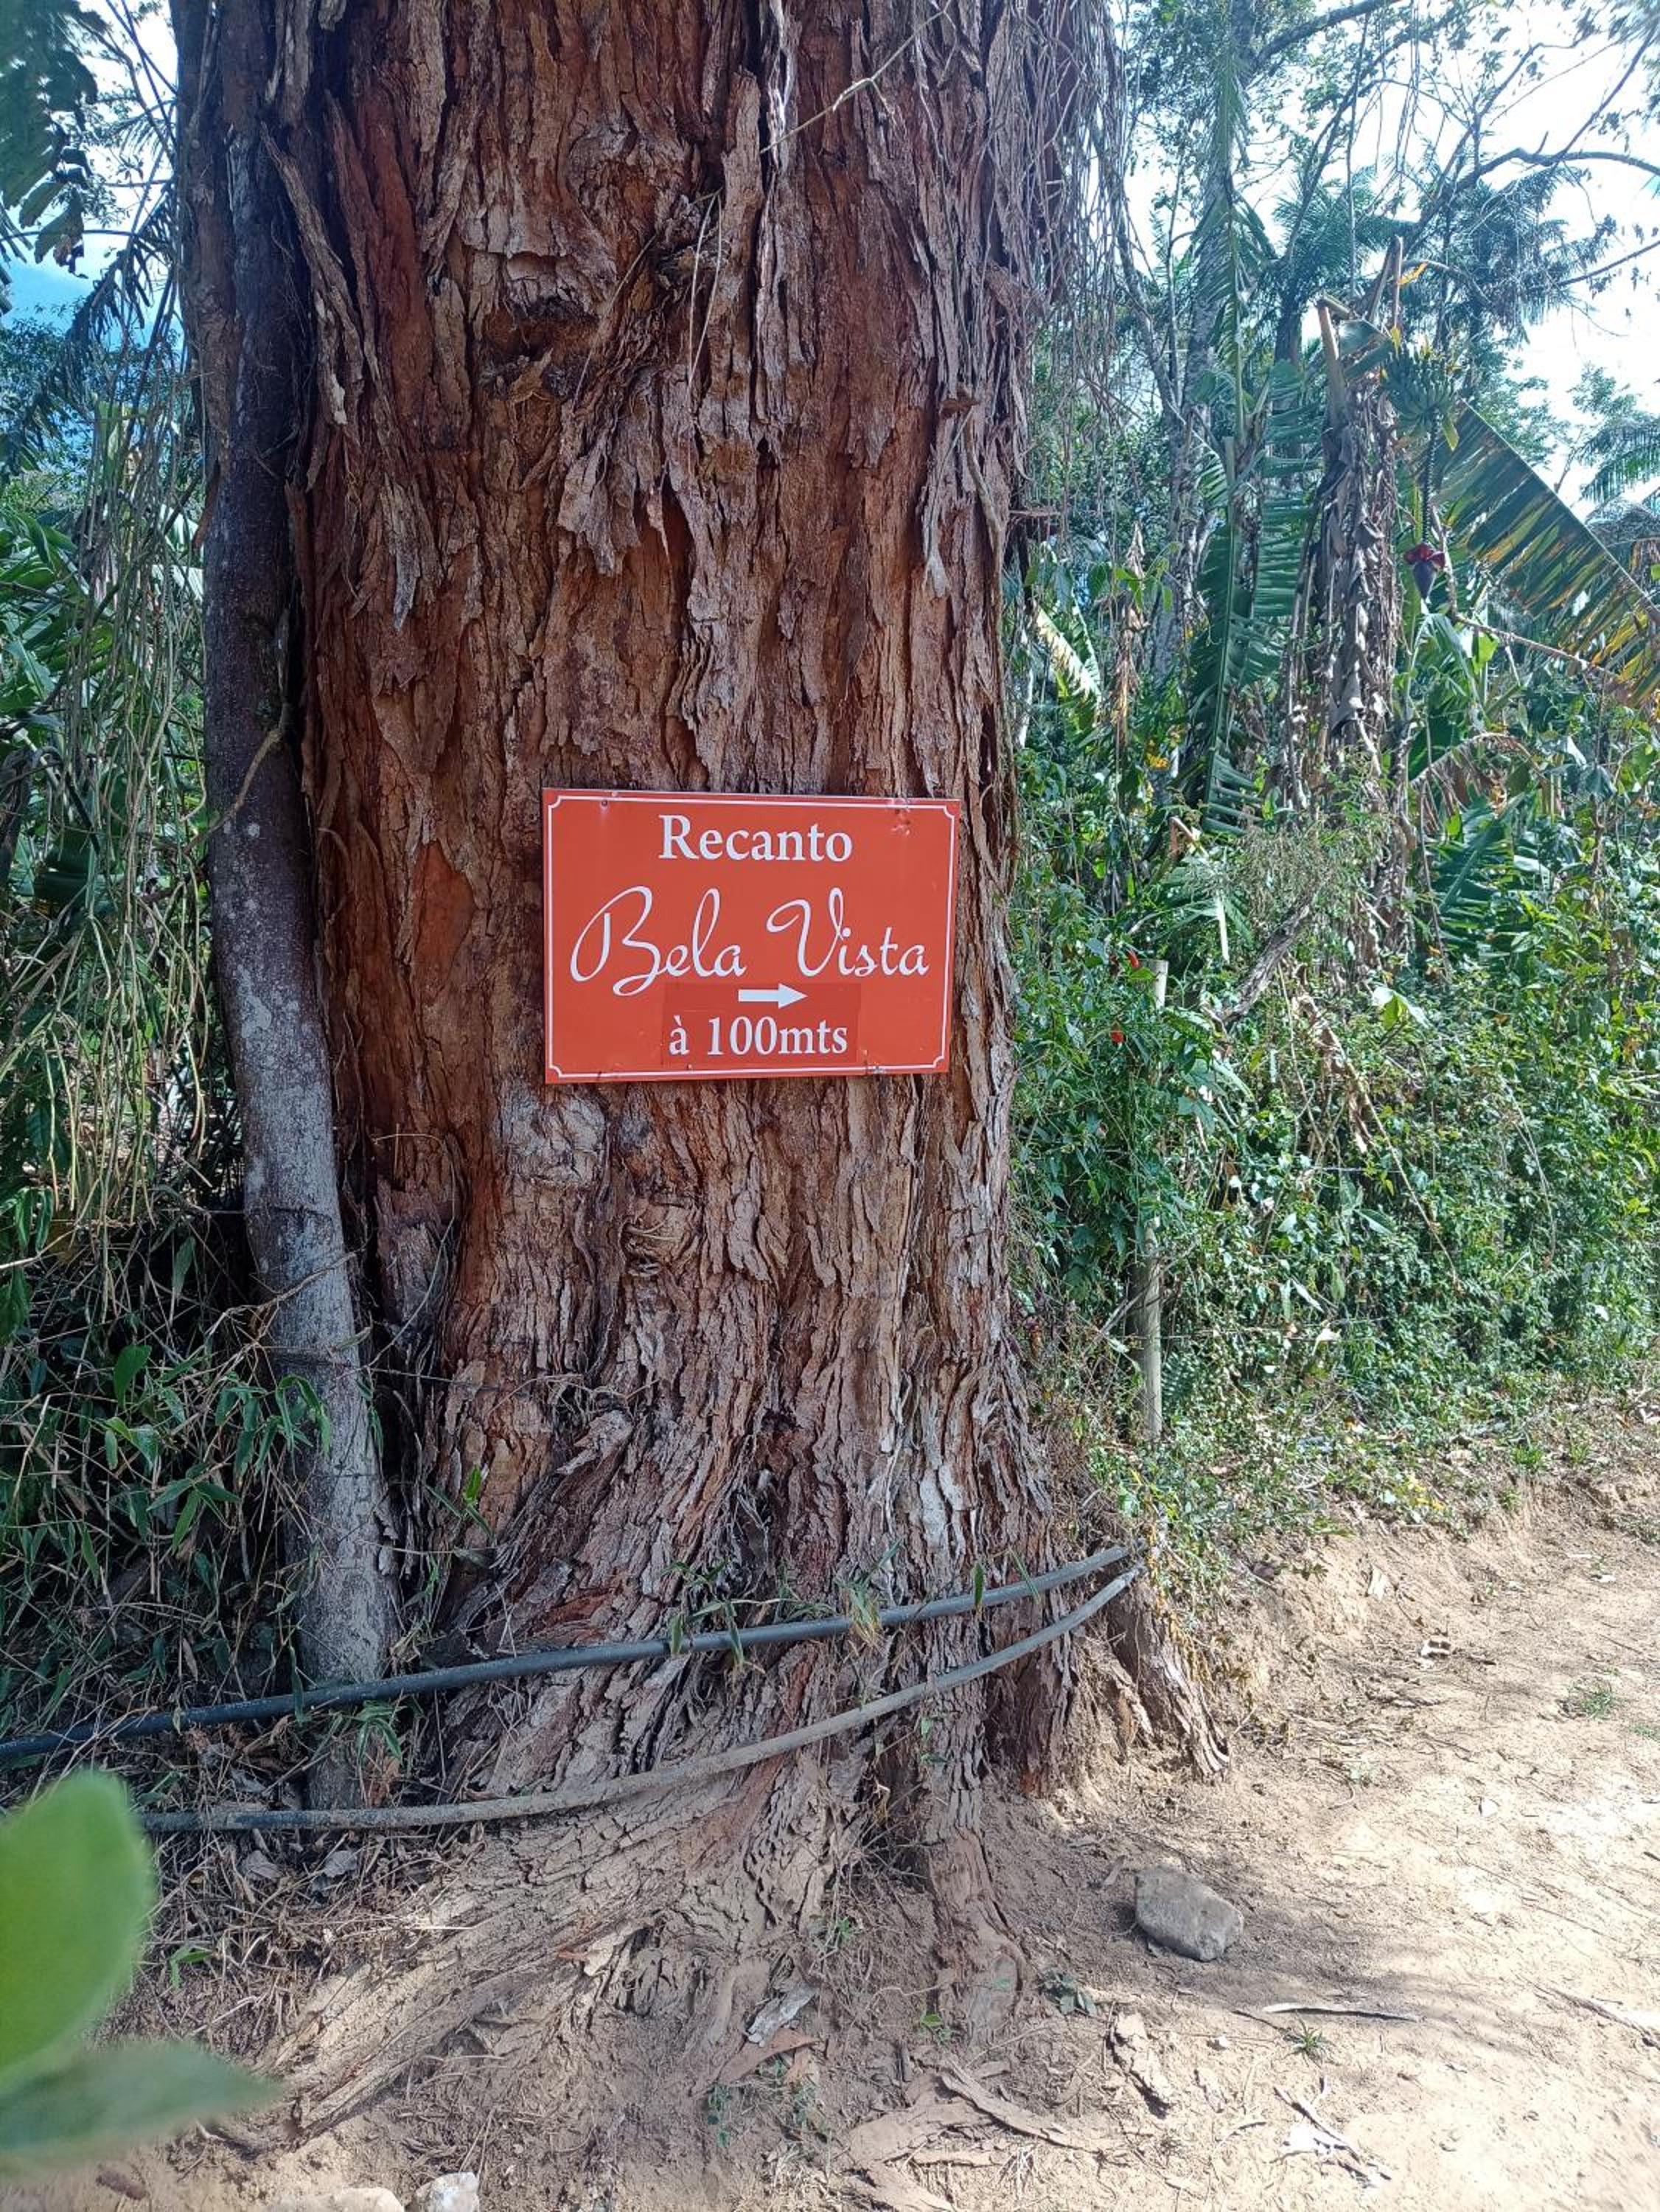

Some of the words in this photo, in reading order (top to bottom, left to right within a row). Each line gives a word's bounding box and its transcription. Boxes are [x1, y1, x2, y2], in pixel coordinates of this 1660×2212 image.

[660, 815, 852, 861] Recanto
[571, 886, 746, 997] Bela
[767, 888, 929, 977] Vista
[669, 1015, 689, 1055] à
[707, 1016, 848, 1055] 100mts
